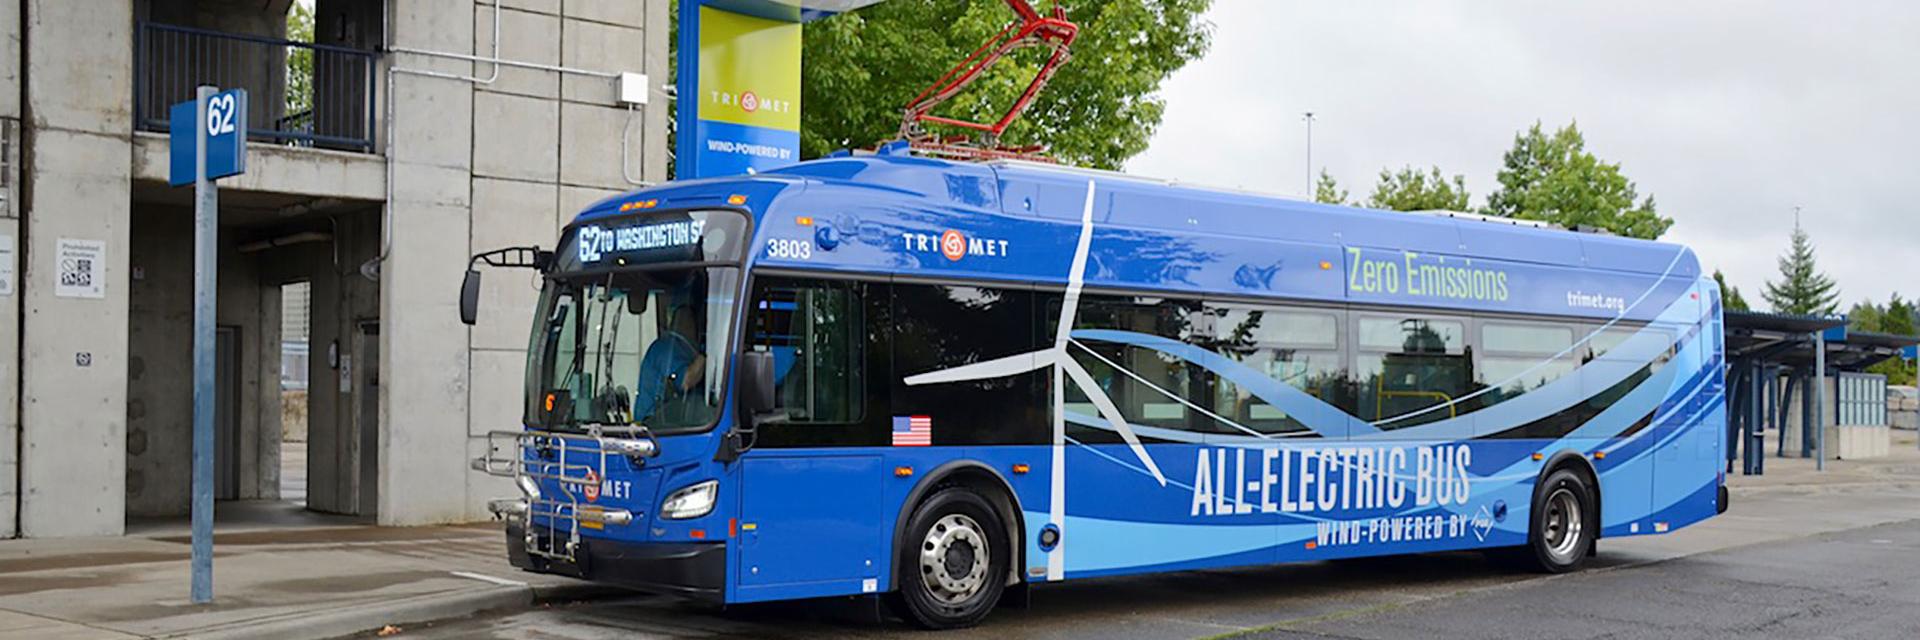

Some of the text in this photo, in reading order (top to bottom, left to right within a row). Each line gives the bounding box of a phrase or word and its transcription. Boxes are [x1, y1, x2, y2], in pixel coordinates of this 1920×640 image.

[711, 90, 789, 113] TRI MET
[208, 94, 234, 136] 62
[707, 139, 791, 159] WIND-POWERED BY
[580, 226, 600, 262] 62
[601, 231, 613, 252] TO
[616, 222, 688, 250] WASHINGTON
[767, 238, 811, 259] 3803
[902, 233, 1009, 257] TRI MET
[1347, 246, 1509, 301] Zero Emissions
[1567, 290, 1625, 314] trimet.org
[601, 480, 631, 499] MET
[1191, 444, 1471, 516] ALL-ELECTRIC BUS
[1317, 514, 1467, 546] WIND-POWERED BY
